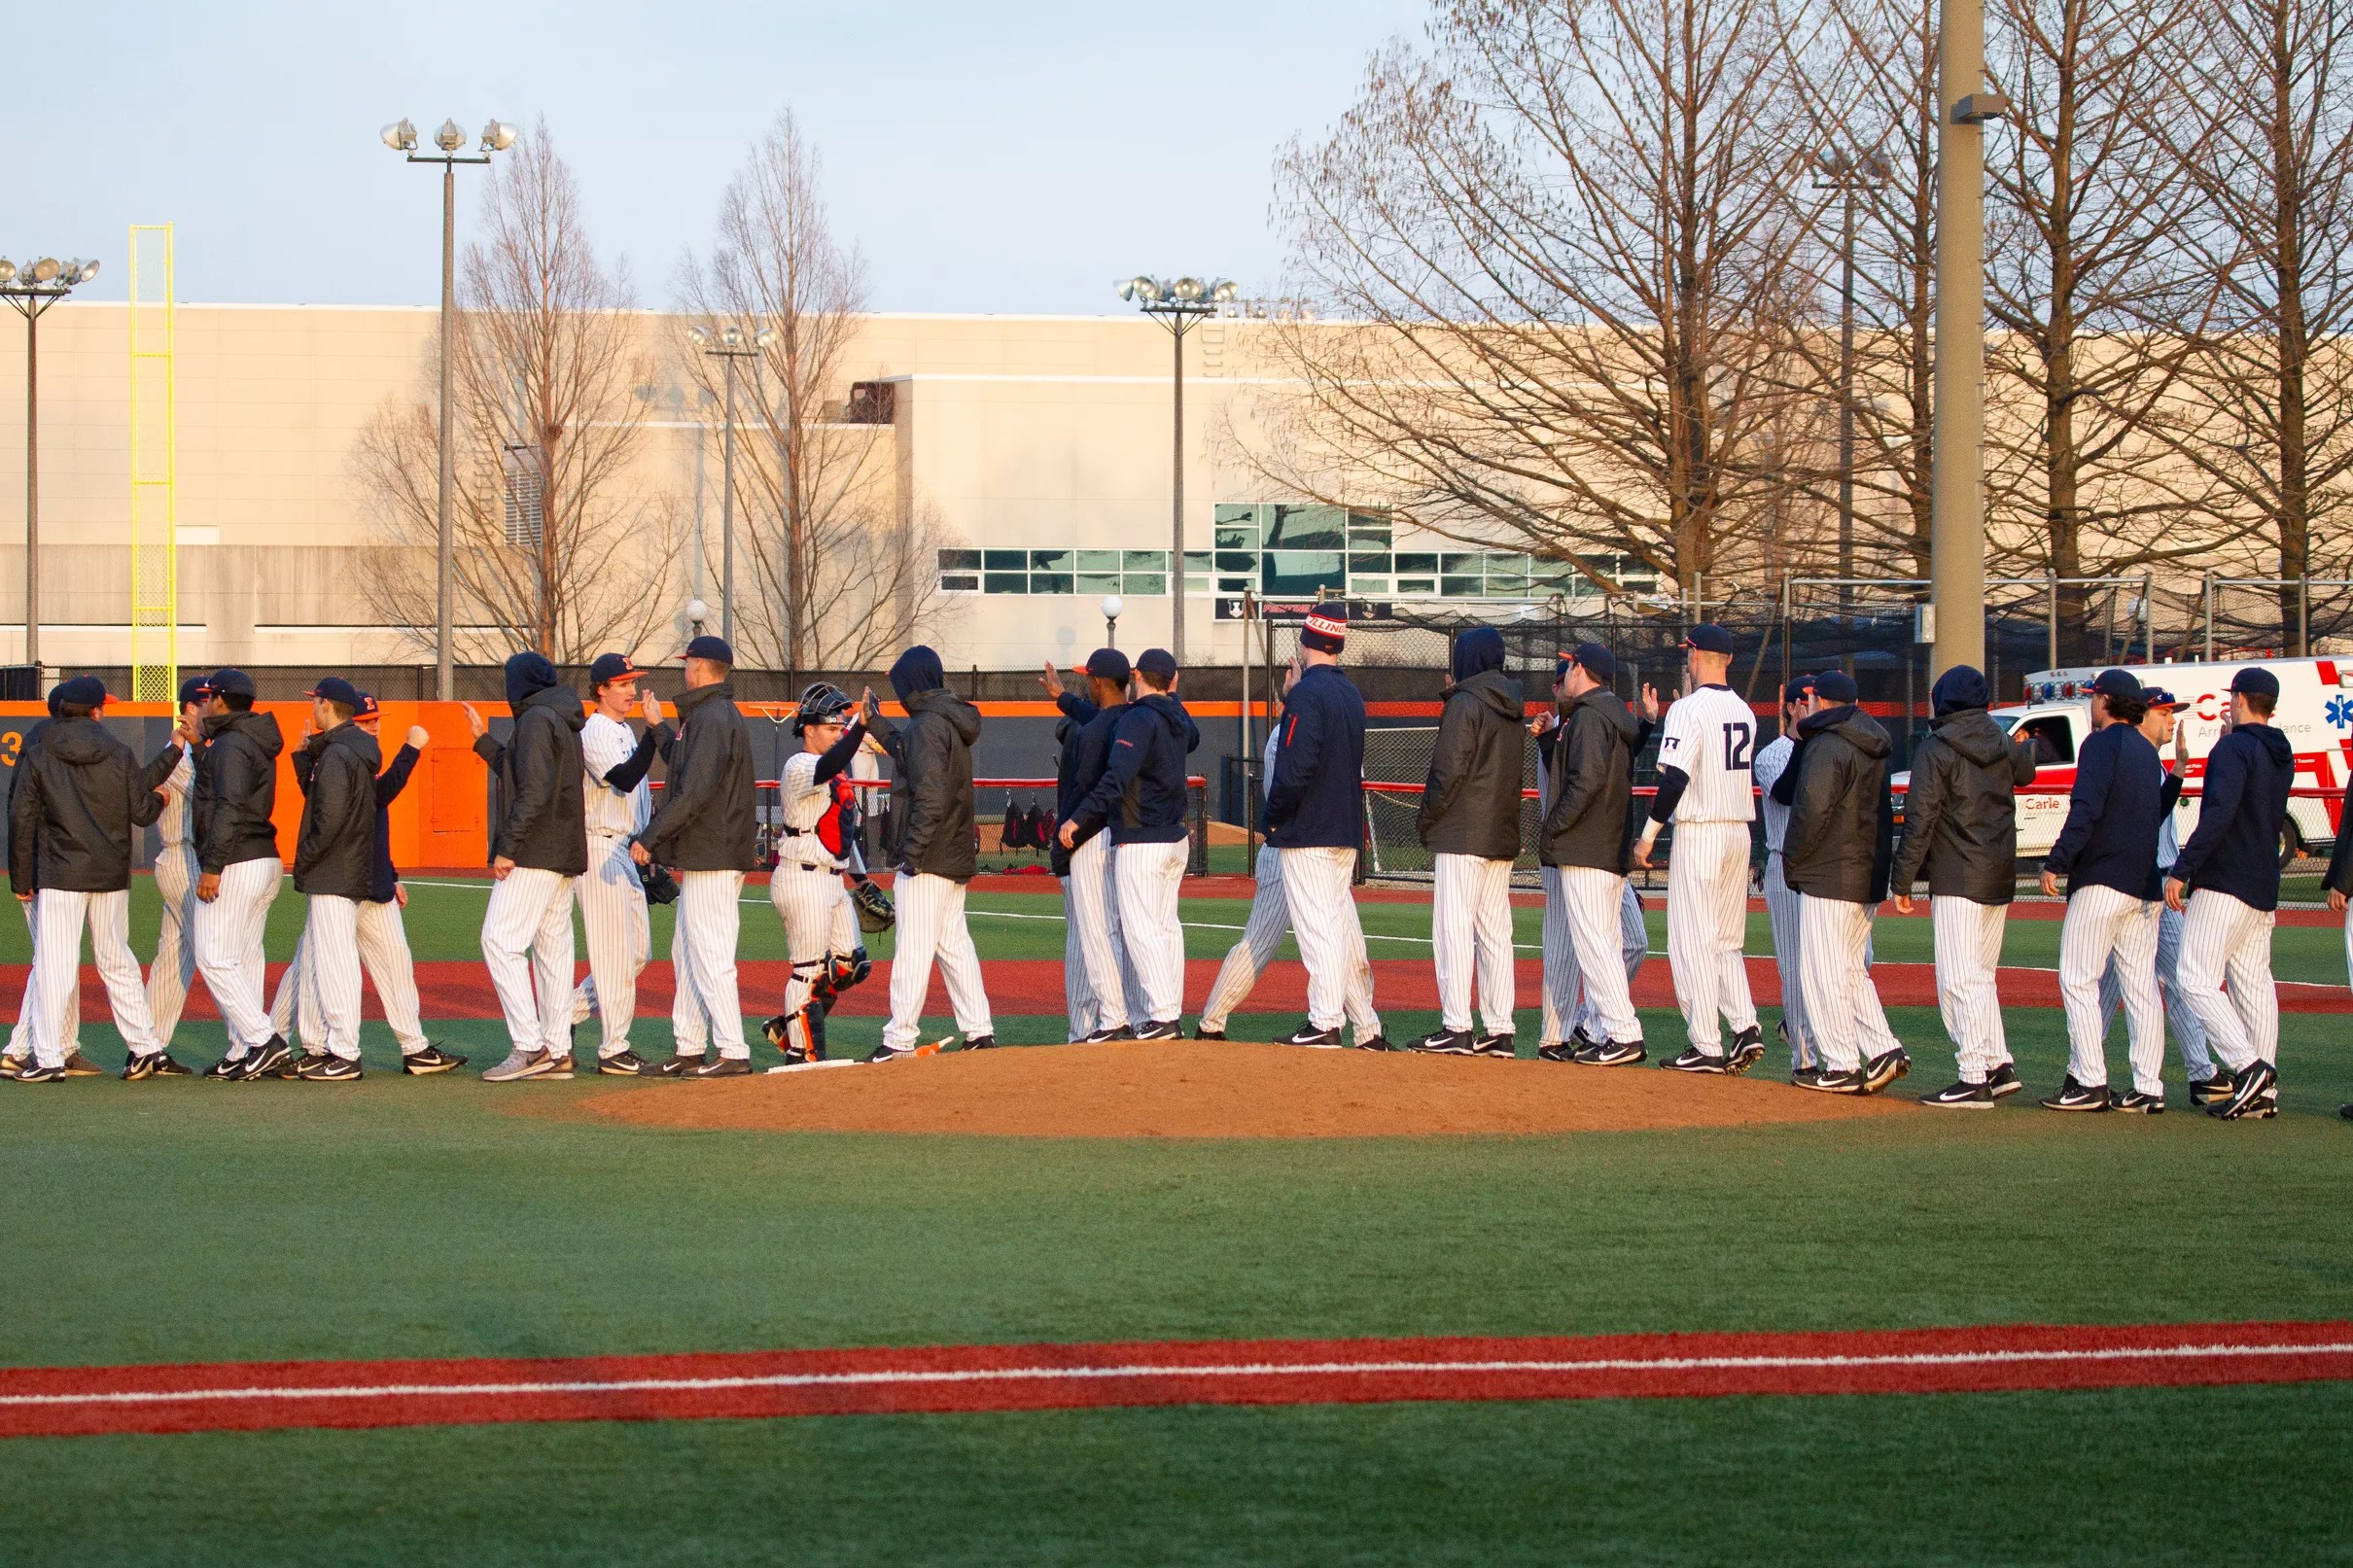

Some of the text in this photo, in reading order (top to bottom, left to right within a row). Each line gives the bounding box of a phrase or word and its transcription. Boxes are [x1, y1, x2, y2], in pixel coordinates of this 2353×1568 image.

[1, 731, 22, 767] 3
[1723, 722, 1750, 771] 12
[2025, 797, 2059, 810] Carle
